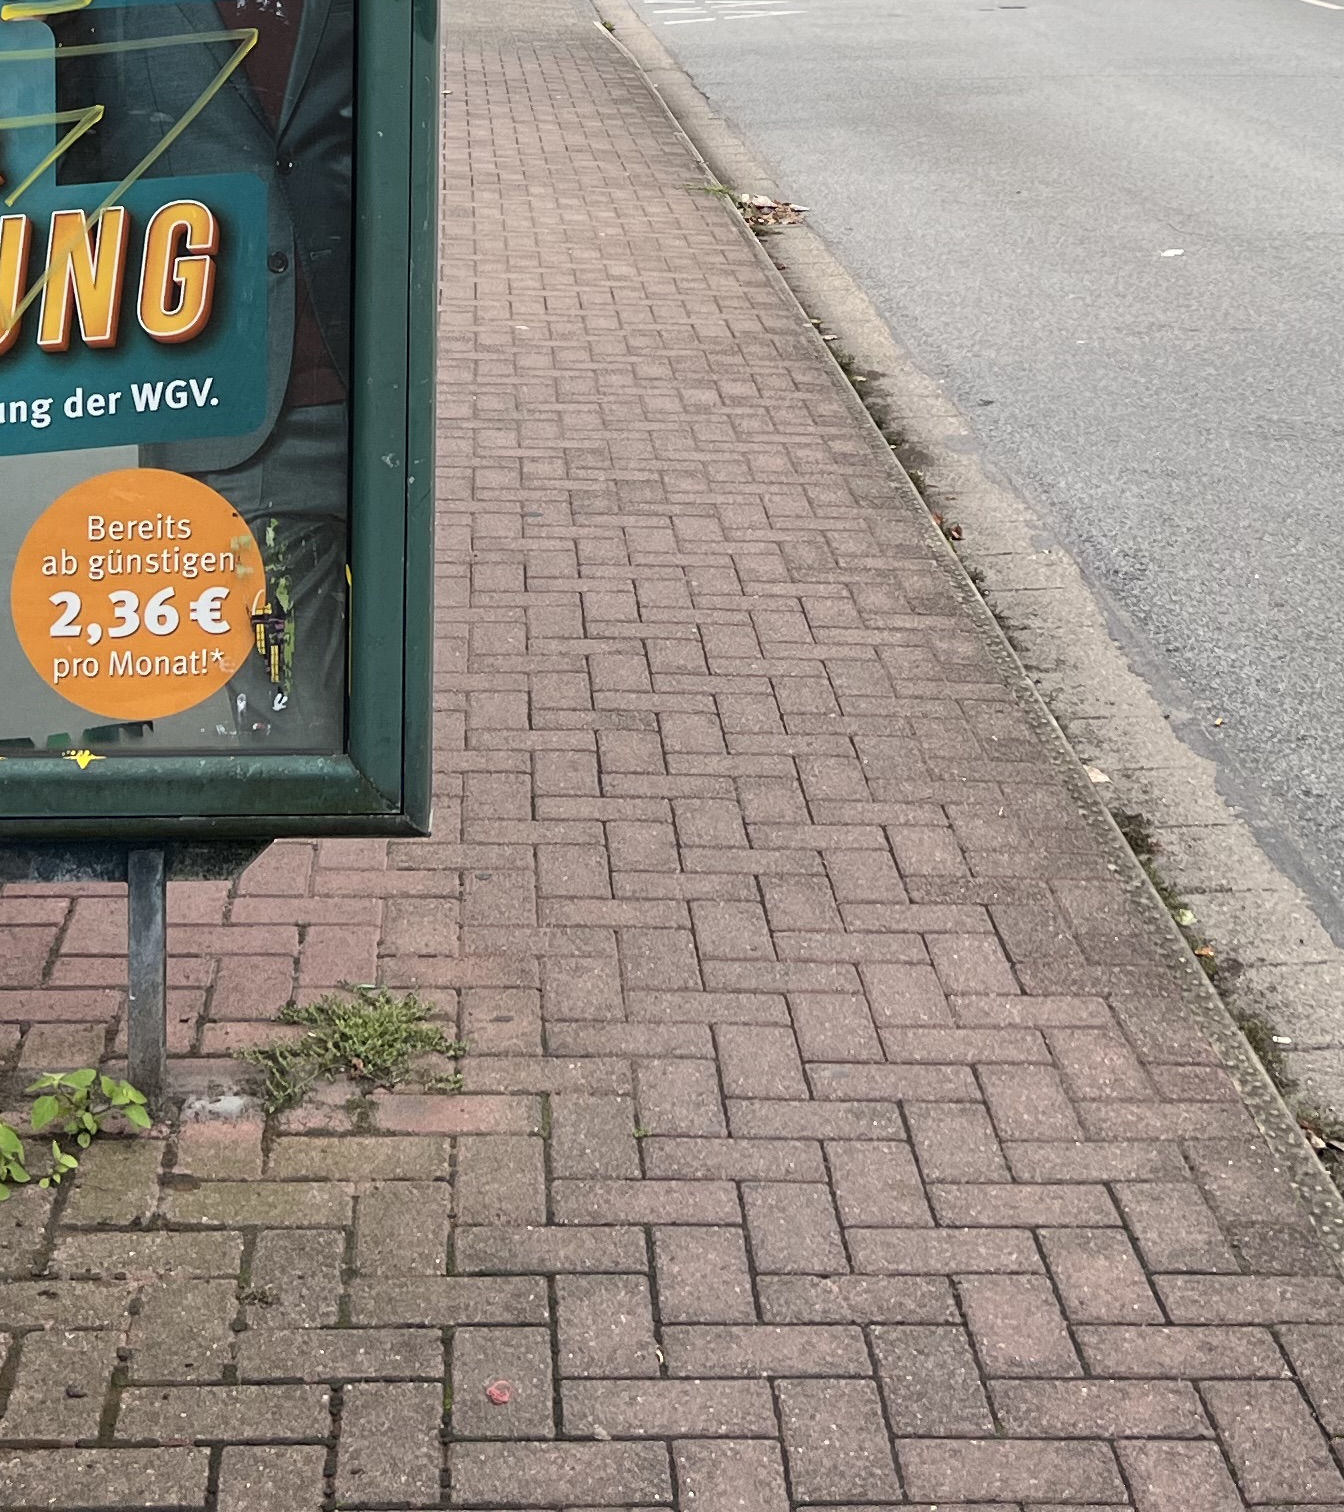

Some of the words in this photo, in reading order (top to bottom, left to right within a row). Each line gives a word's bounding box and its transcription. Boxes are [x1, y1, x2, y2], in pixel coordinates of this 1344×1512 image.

[63, 384, 122, 420] der
[132, 376, 220, 414] WGV.
[86, 514, 192, 542] Bereits
[41, 549, 78, 577] ab
[88, 547, 236, 581] günstigen
[52, 657, 100, 684] pro
